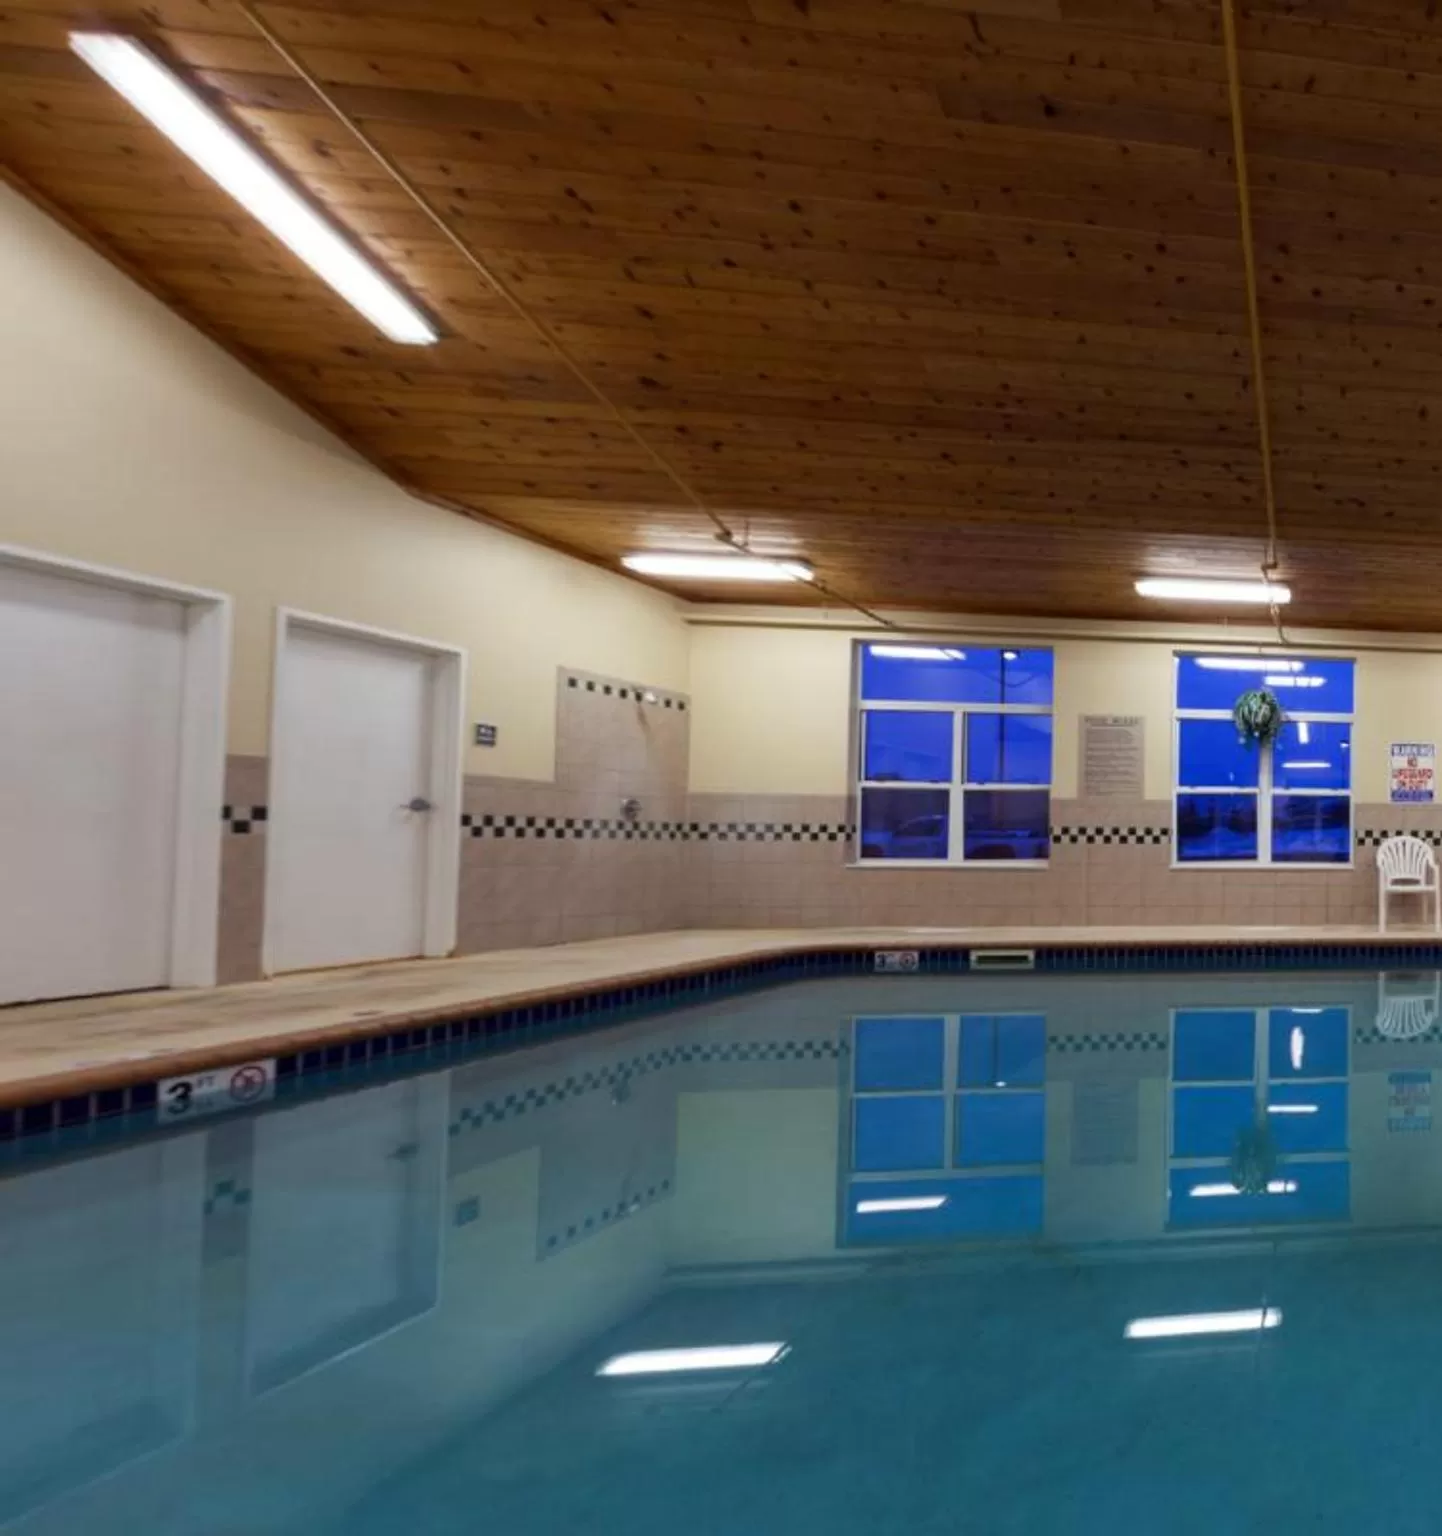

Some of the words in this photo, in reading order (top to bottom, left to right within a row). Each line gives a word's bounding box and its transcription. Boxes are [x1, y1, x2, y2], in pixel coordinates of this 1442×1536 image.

[1407, 757, 1418, 767] NO
[1392, 768, 1433, 779] LIFEGUARD
[167, 1081, 193, 1115] 3
